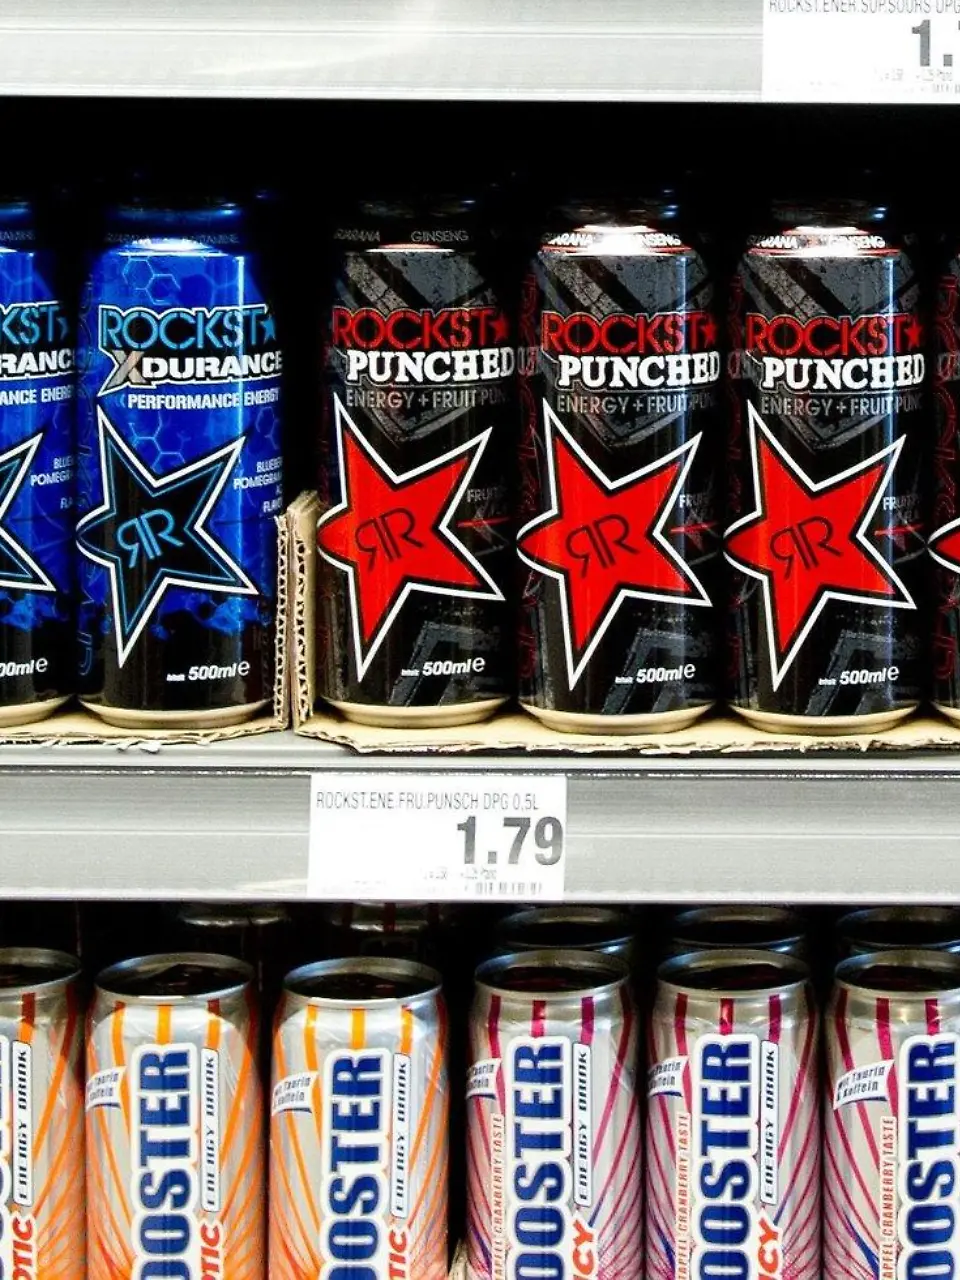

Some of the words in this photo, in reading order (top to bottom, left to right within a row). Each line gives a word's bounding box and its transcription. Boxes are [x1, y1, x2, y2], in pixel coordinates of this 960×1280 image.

[410, 230, 469, 242] GINSENG
[347, 347, 516, 382] PUNCHED
[558, 351, 720, 387] PUNCHED
[763, 354, 925, 390] PUNCHED
[127, 392, 240, 410] PERFORMANCE
[345, 388, 414, 410] ENERGY
[432, 387, 479, 408] FRUIT
[556, 394, 626, 414] ENERGY
[647, 393, 690, 413] FRUIT
[762, 397, 830, 417] ENERGY
[850, 396, 893, 417] FRUIT
[483, 793, 508, 810] DPG
[457, 815, 563, 865] 1.79
